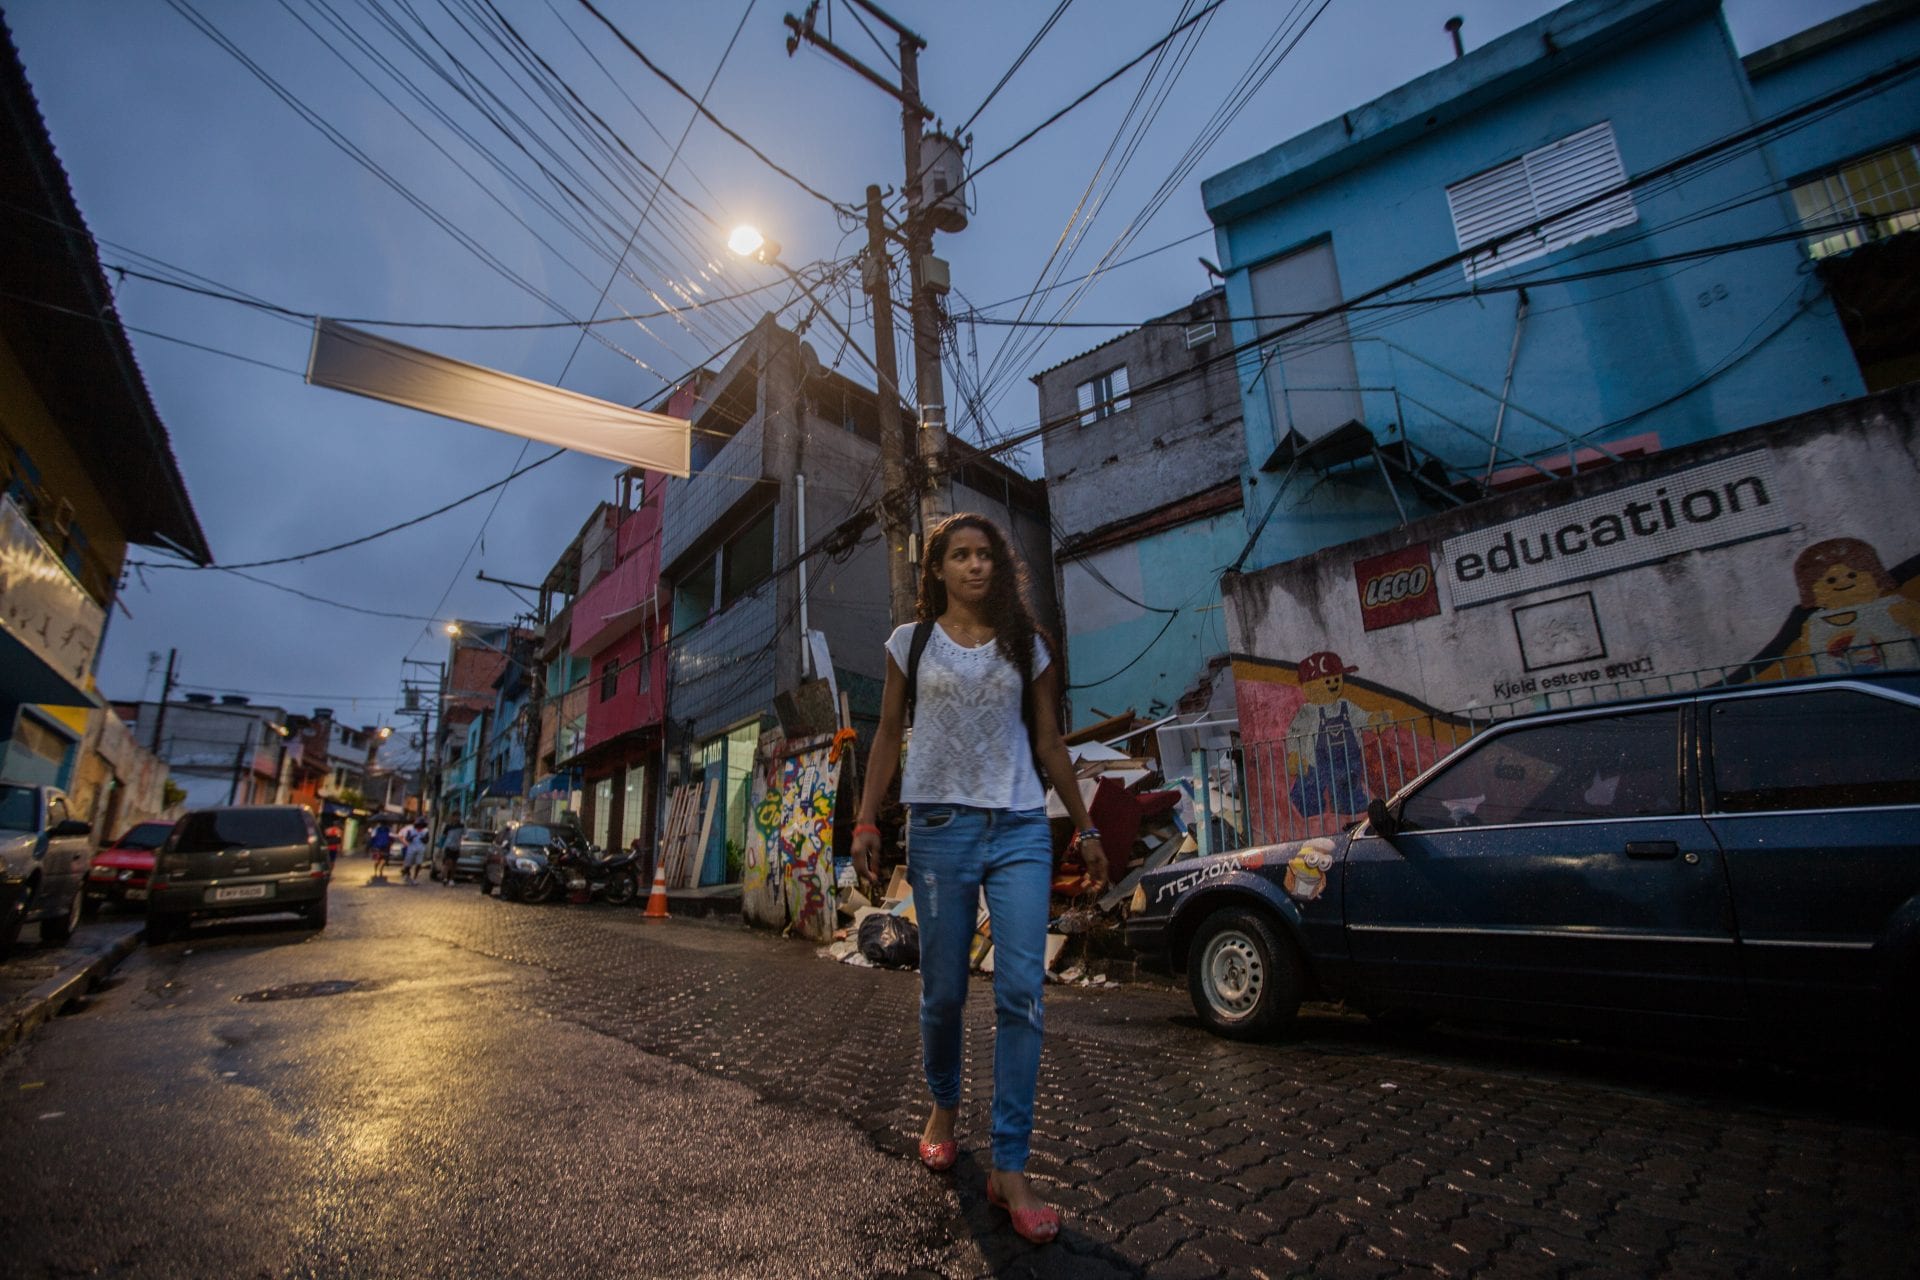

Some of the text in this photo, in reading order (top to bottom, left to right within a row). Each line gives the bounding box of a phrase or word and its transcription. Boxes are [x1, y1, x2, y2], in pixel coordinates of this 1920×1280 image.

[1365, 474, 1772, 606] LEGO education
[1493, 678, 1537, 698] Kjeld
[1541, 669, 1600, 689] esteve
[1155, 858, 1242, 903] STETSOM
